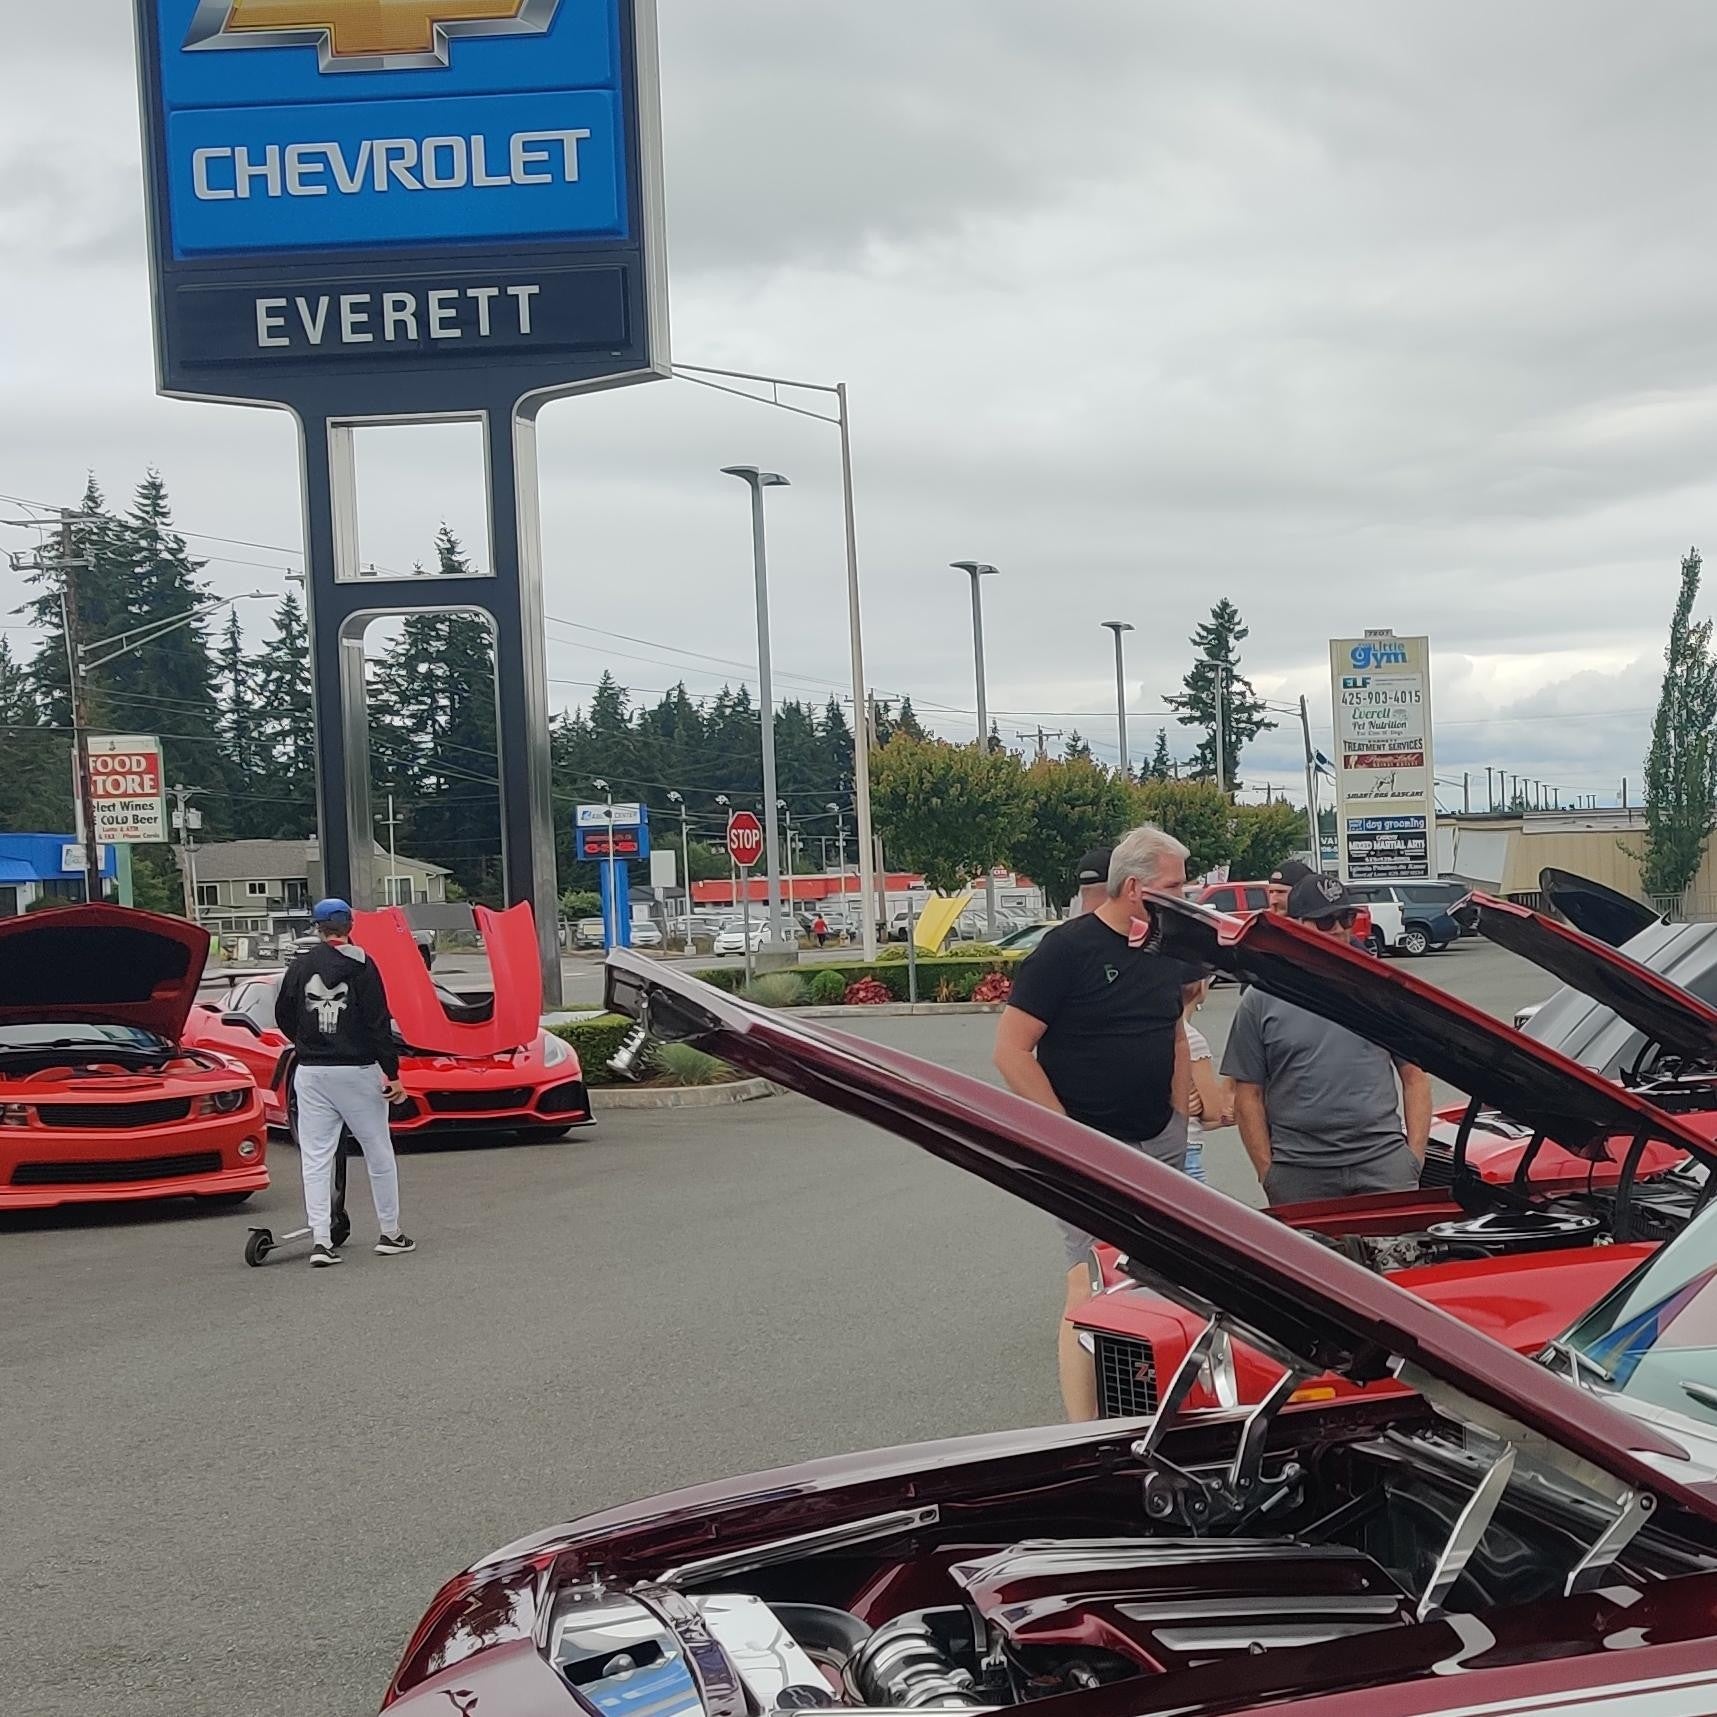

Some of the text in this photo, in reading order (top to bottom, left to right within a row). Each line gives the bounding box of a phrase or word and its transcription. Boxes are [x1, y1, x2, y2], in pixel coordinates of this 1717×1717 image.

[192, 128, 591, 200] CHEVROLET
[255, 285, 541, 348] EVERETT
[1350, 643, 1408, 669] gym
[1342, 677, 1371, 689] ELF
[1341, 690, 1421, 706] 425-903-4015
[1368, 720, 1407, 730] Nutrition
[1343, 737, 1423, 752] TREATMENT SERVICES
[90, 774, 157, 795] TORE
[92, 801, 154, 812] elect Wines
[100, 815, 128, 826] COLD
[132, 814, 158, 825] Beer
[1366, 820, 1382, 830] dog
[1384, 818, 1425, 829] grooming
[730, 829, 760, 849] STOP
[1373, 840, 1406, 850] MARTIAL
